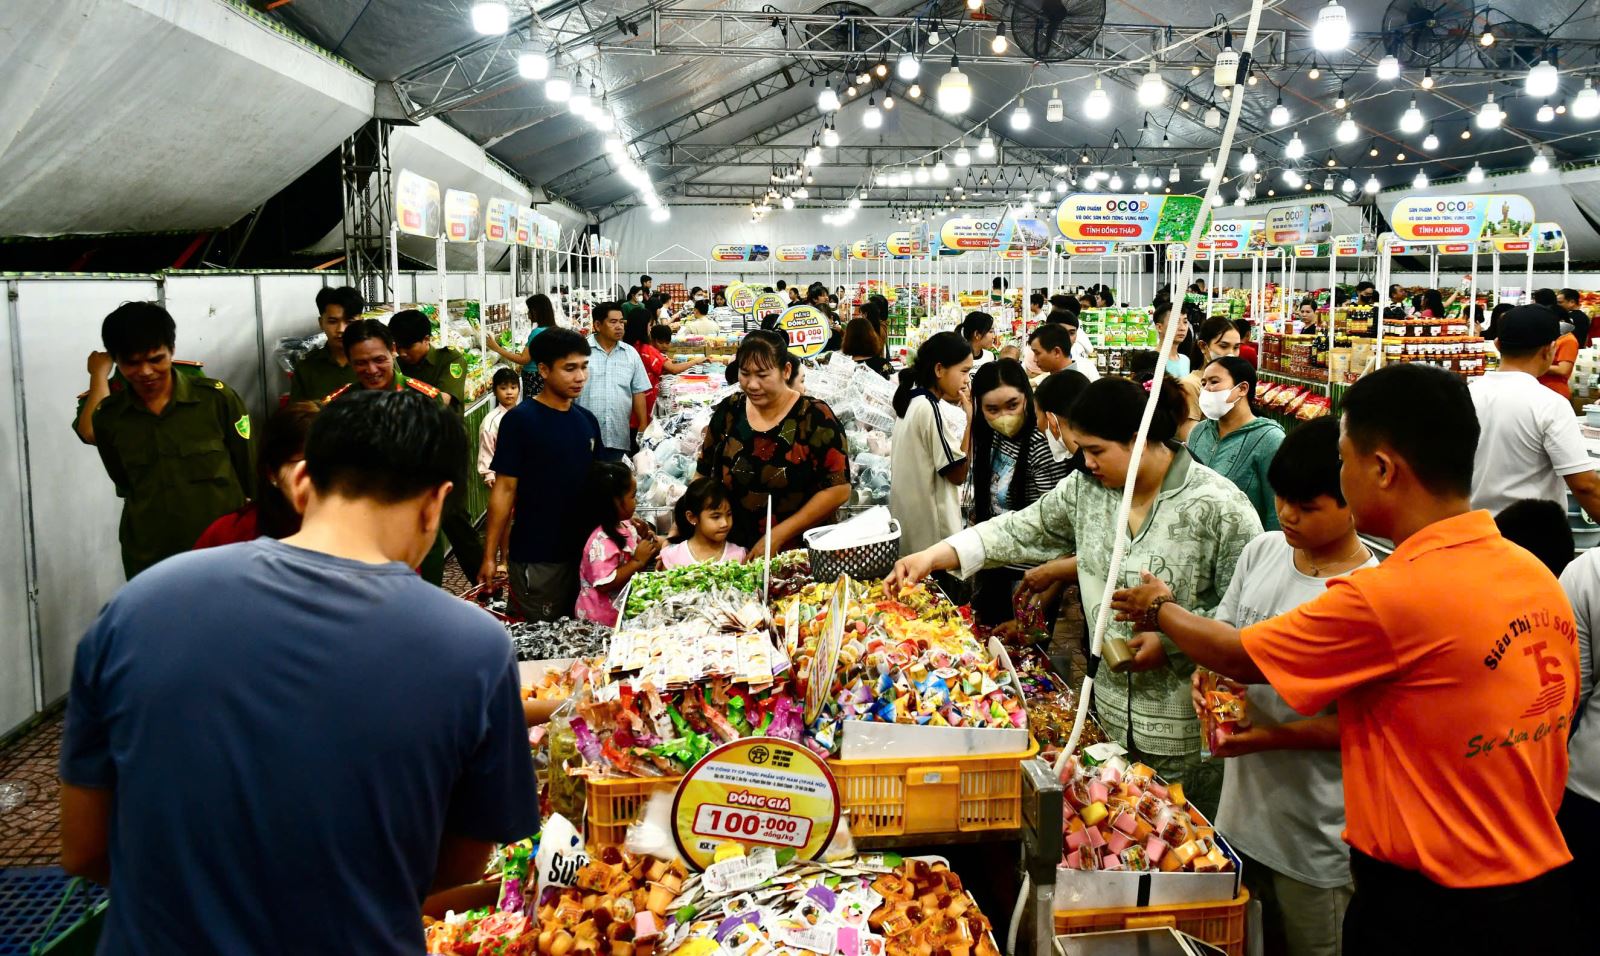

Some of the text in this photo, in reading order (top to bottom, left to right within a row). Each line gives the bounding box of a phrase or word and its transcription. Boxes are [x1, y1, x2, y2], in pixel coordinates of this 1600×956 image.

[1106, 200, 1148, 212] OCOP
[1436, 201, 1474, 212] OCOP
[1086, 225, 1100, 233] TỈNH
[1120, 226, 1136, 234] THÁP
[1484, 634, 1511, 670] Siêu
[1509, 615, 1532, 638] Thị
[1554, 616, 1576, 645] SƠN
[767, 796, 790, 811] GIÁ
